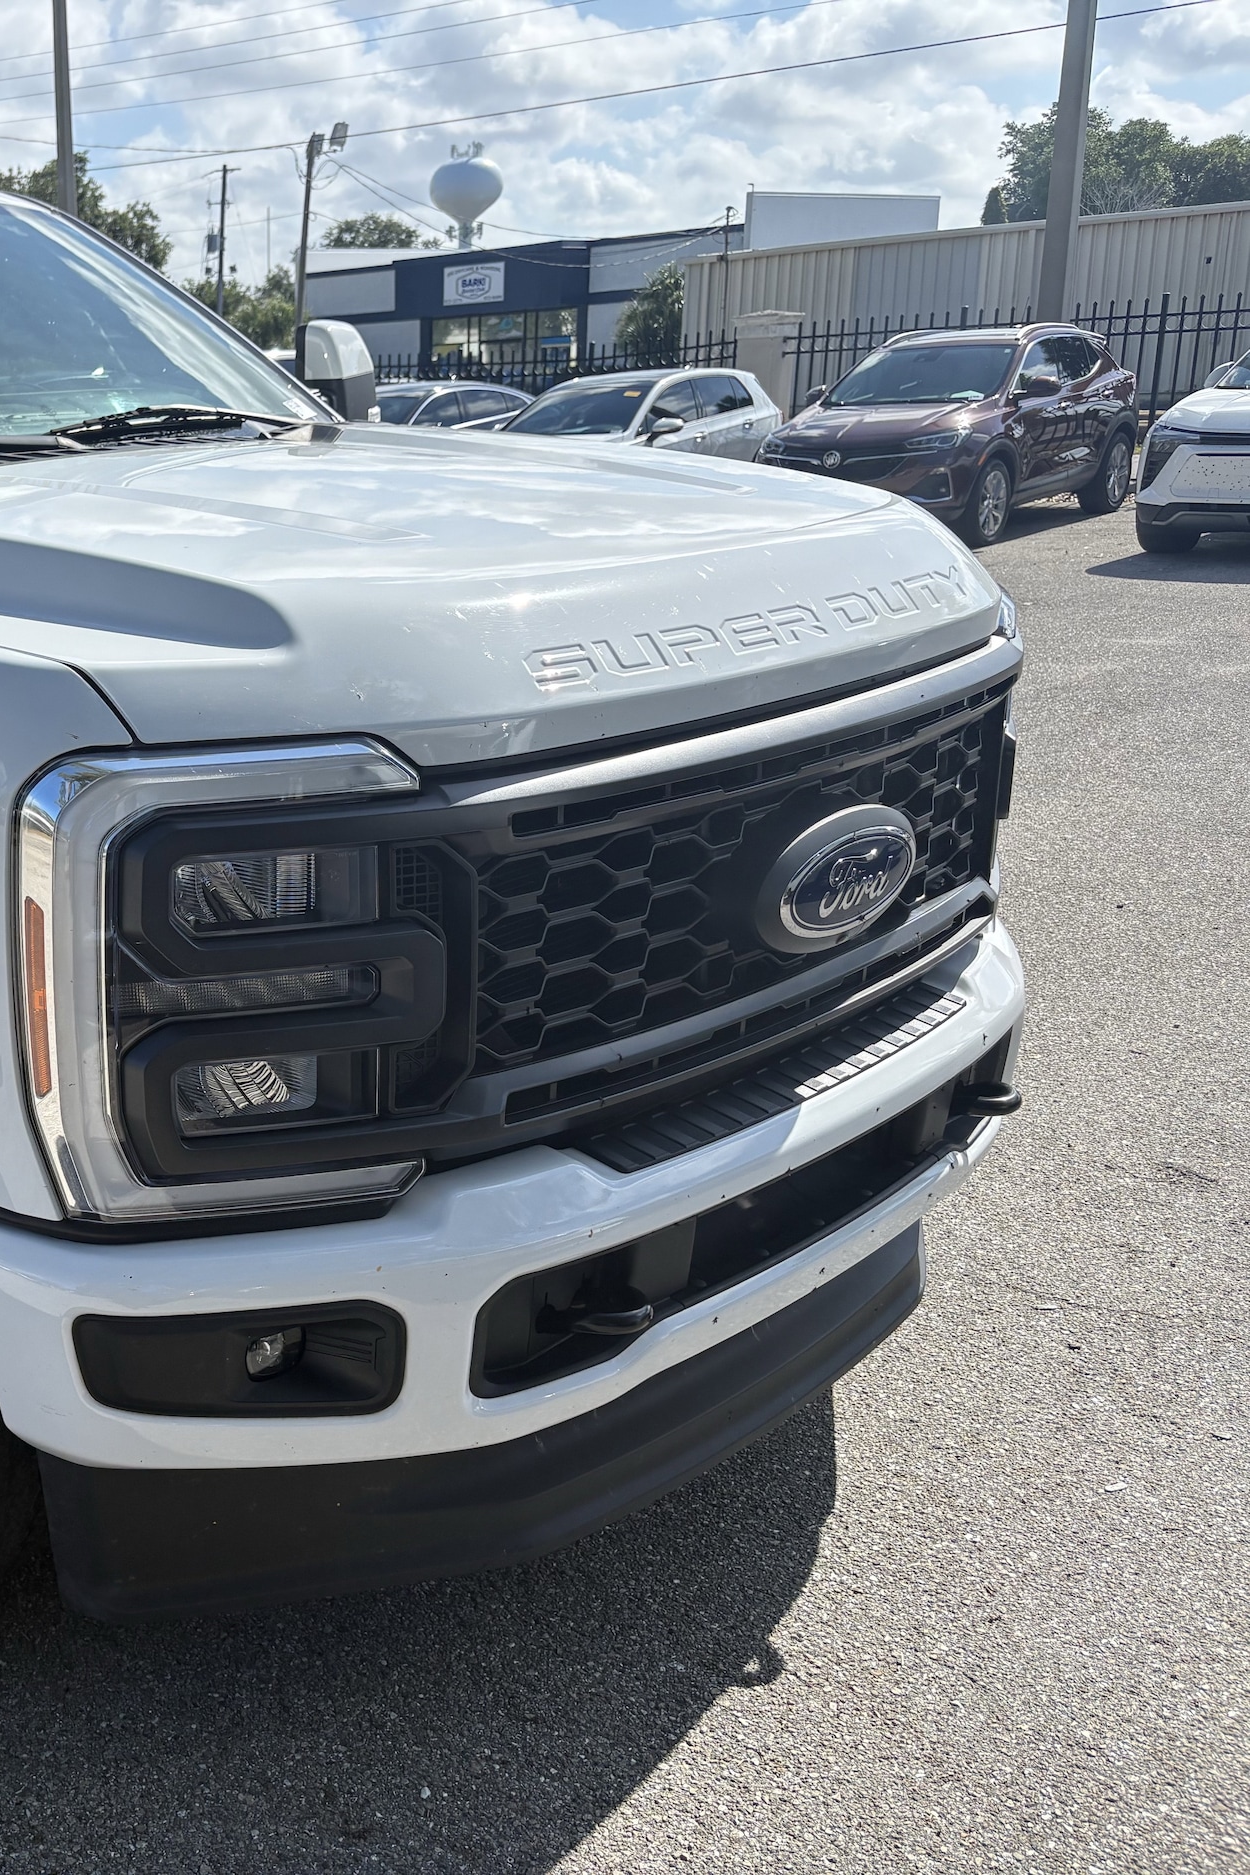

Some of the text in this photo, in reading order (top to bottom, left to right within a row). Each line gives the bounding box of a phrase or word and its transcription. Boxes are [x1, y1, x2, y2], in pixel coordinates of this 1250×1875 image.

[523, 565, 967, 691] SUPER DUTY
[818, 848, 894, 919] Ford
